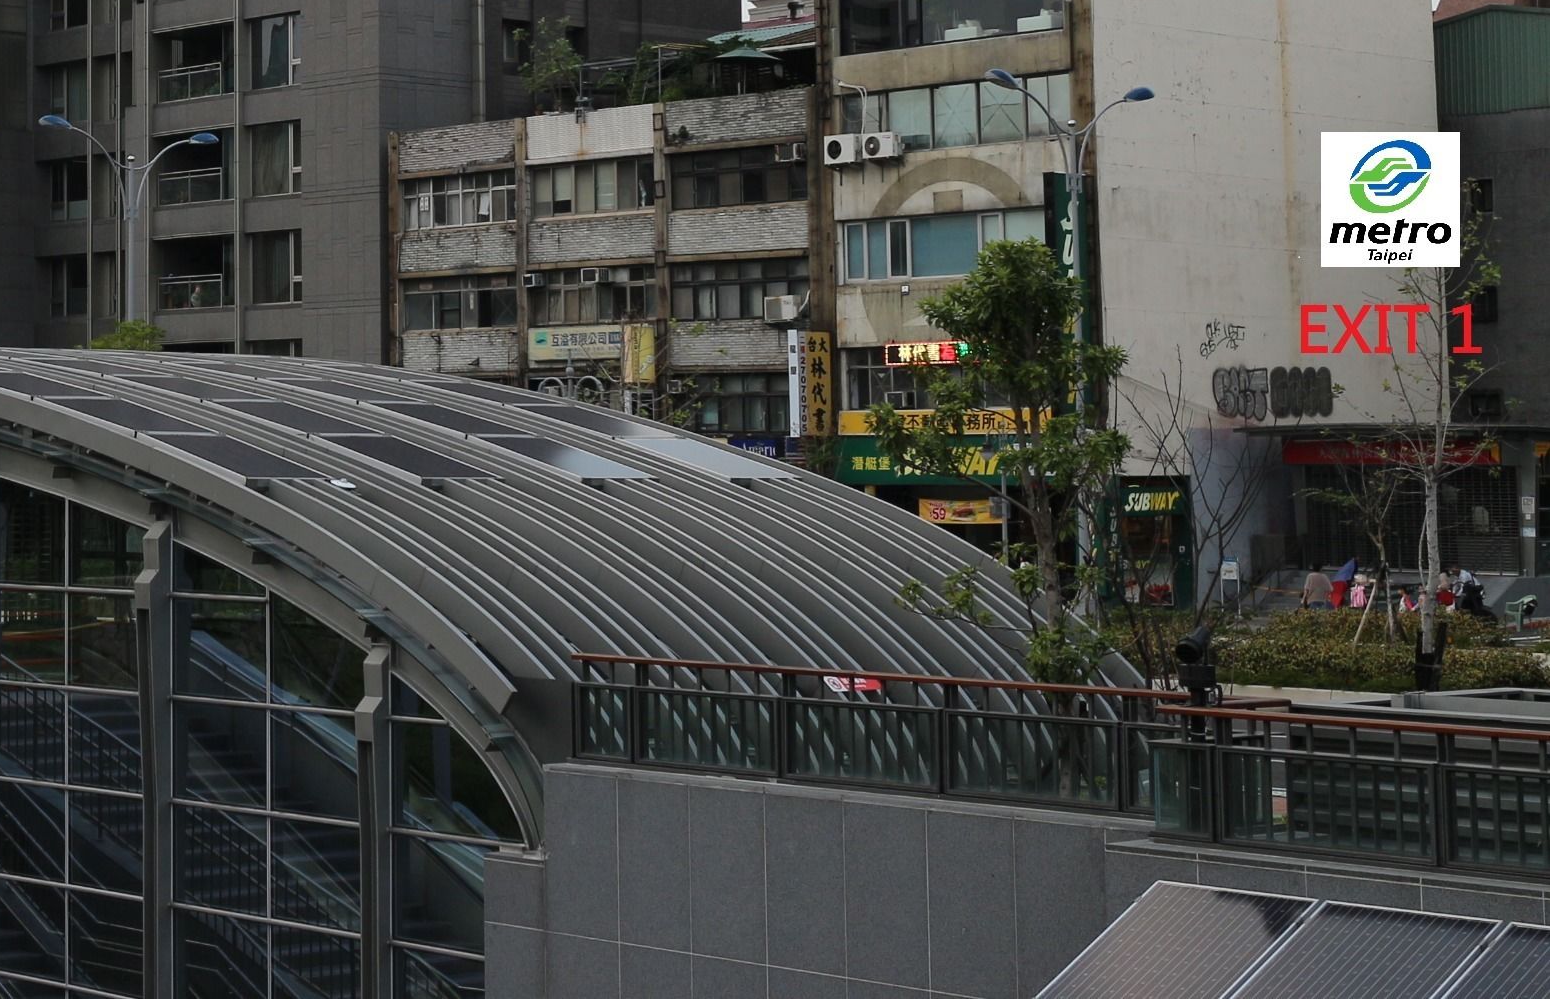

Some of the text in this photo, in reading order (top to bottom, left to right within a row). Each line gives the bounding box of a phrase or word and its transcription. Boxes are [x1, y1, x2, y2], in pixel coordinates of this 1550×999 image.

[852, 457, 891, 471] 潛艇堡
[1125, 491, 1179, 512] SUBWAY
